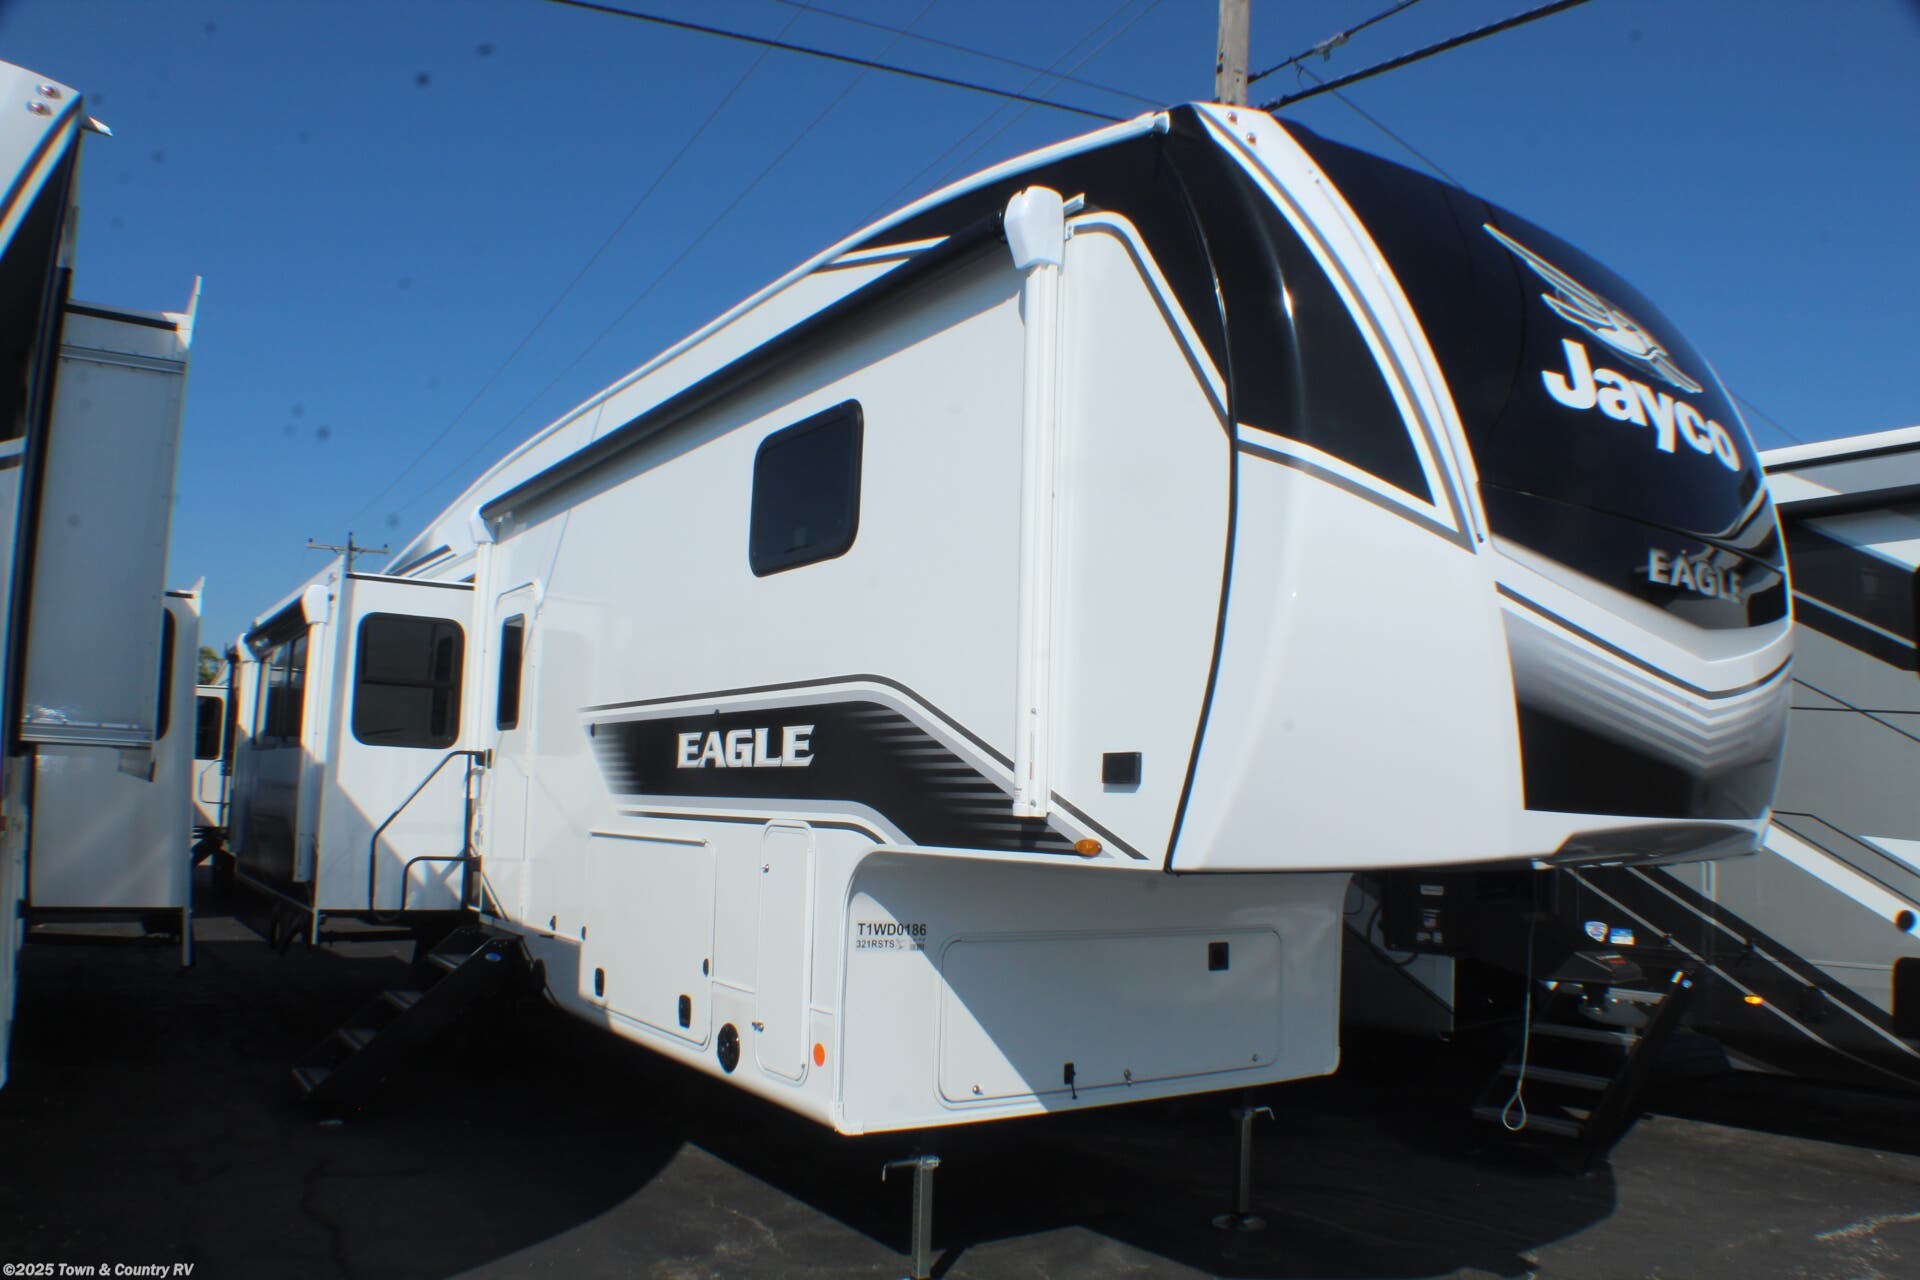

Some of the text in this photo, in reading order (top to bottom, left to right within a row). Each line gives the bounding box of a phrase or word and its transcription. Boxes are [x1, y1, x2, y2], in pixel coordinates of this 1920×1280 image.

[1541, 337, 1742, 472] Jayco
[1648, 548, 1742, 603] EAGLE
[677, 725, 816, 769] EAGLE
[856, 939, 895, 949] 321RSTS
[857, 923, 927, 936] T1WD0186
